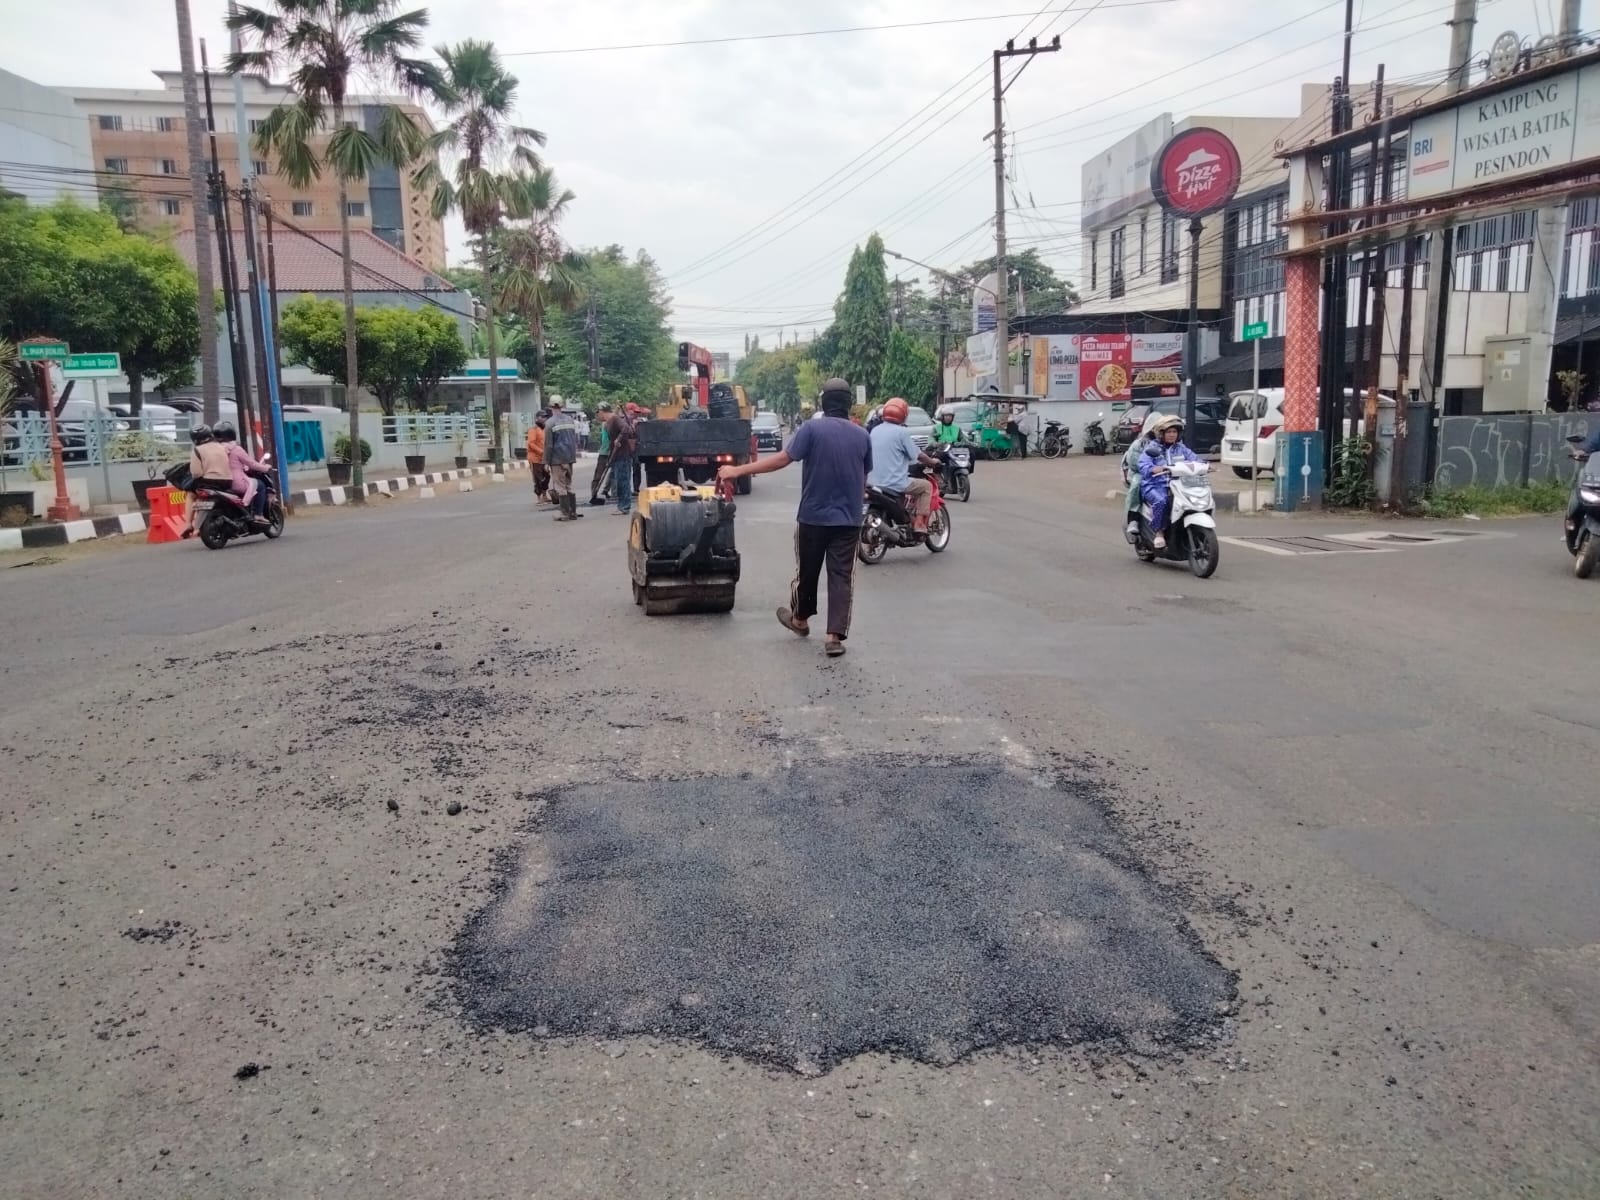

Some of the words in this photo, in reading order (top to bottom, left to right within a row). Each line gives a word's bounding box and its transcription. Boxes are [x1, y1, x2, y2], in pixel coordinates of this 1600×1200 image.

[1478, 83, 1559, 123] KAMPUNG
[1463, 126, 1518, 153] WISATA
[1522, 109, 1573, 140] BATIK
[1414, 138, 1433, 157] BRI
[1474, 144, 1553, 179] PESINDON
[1178, 164, 1222, 193] Pizza
[1185, 176, 1217, 199] Hut
